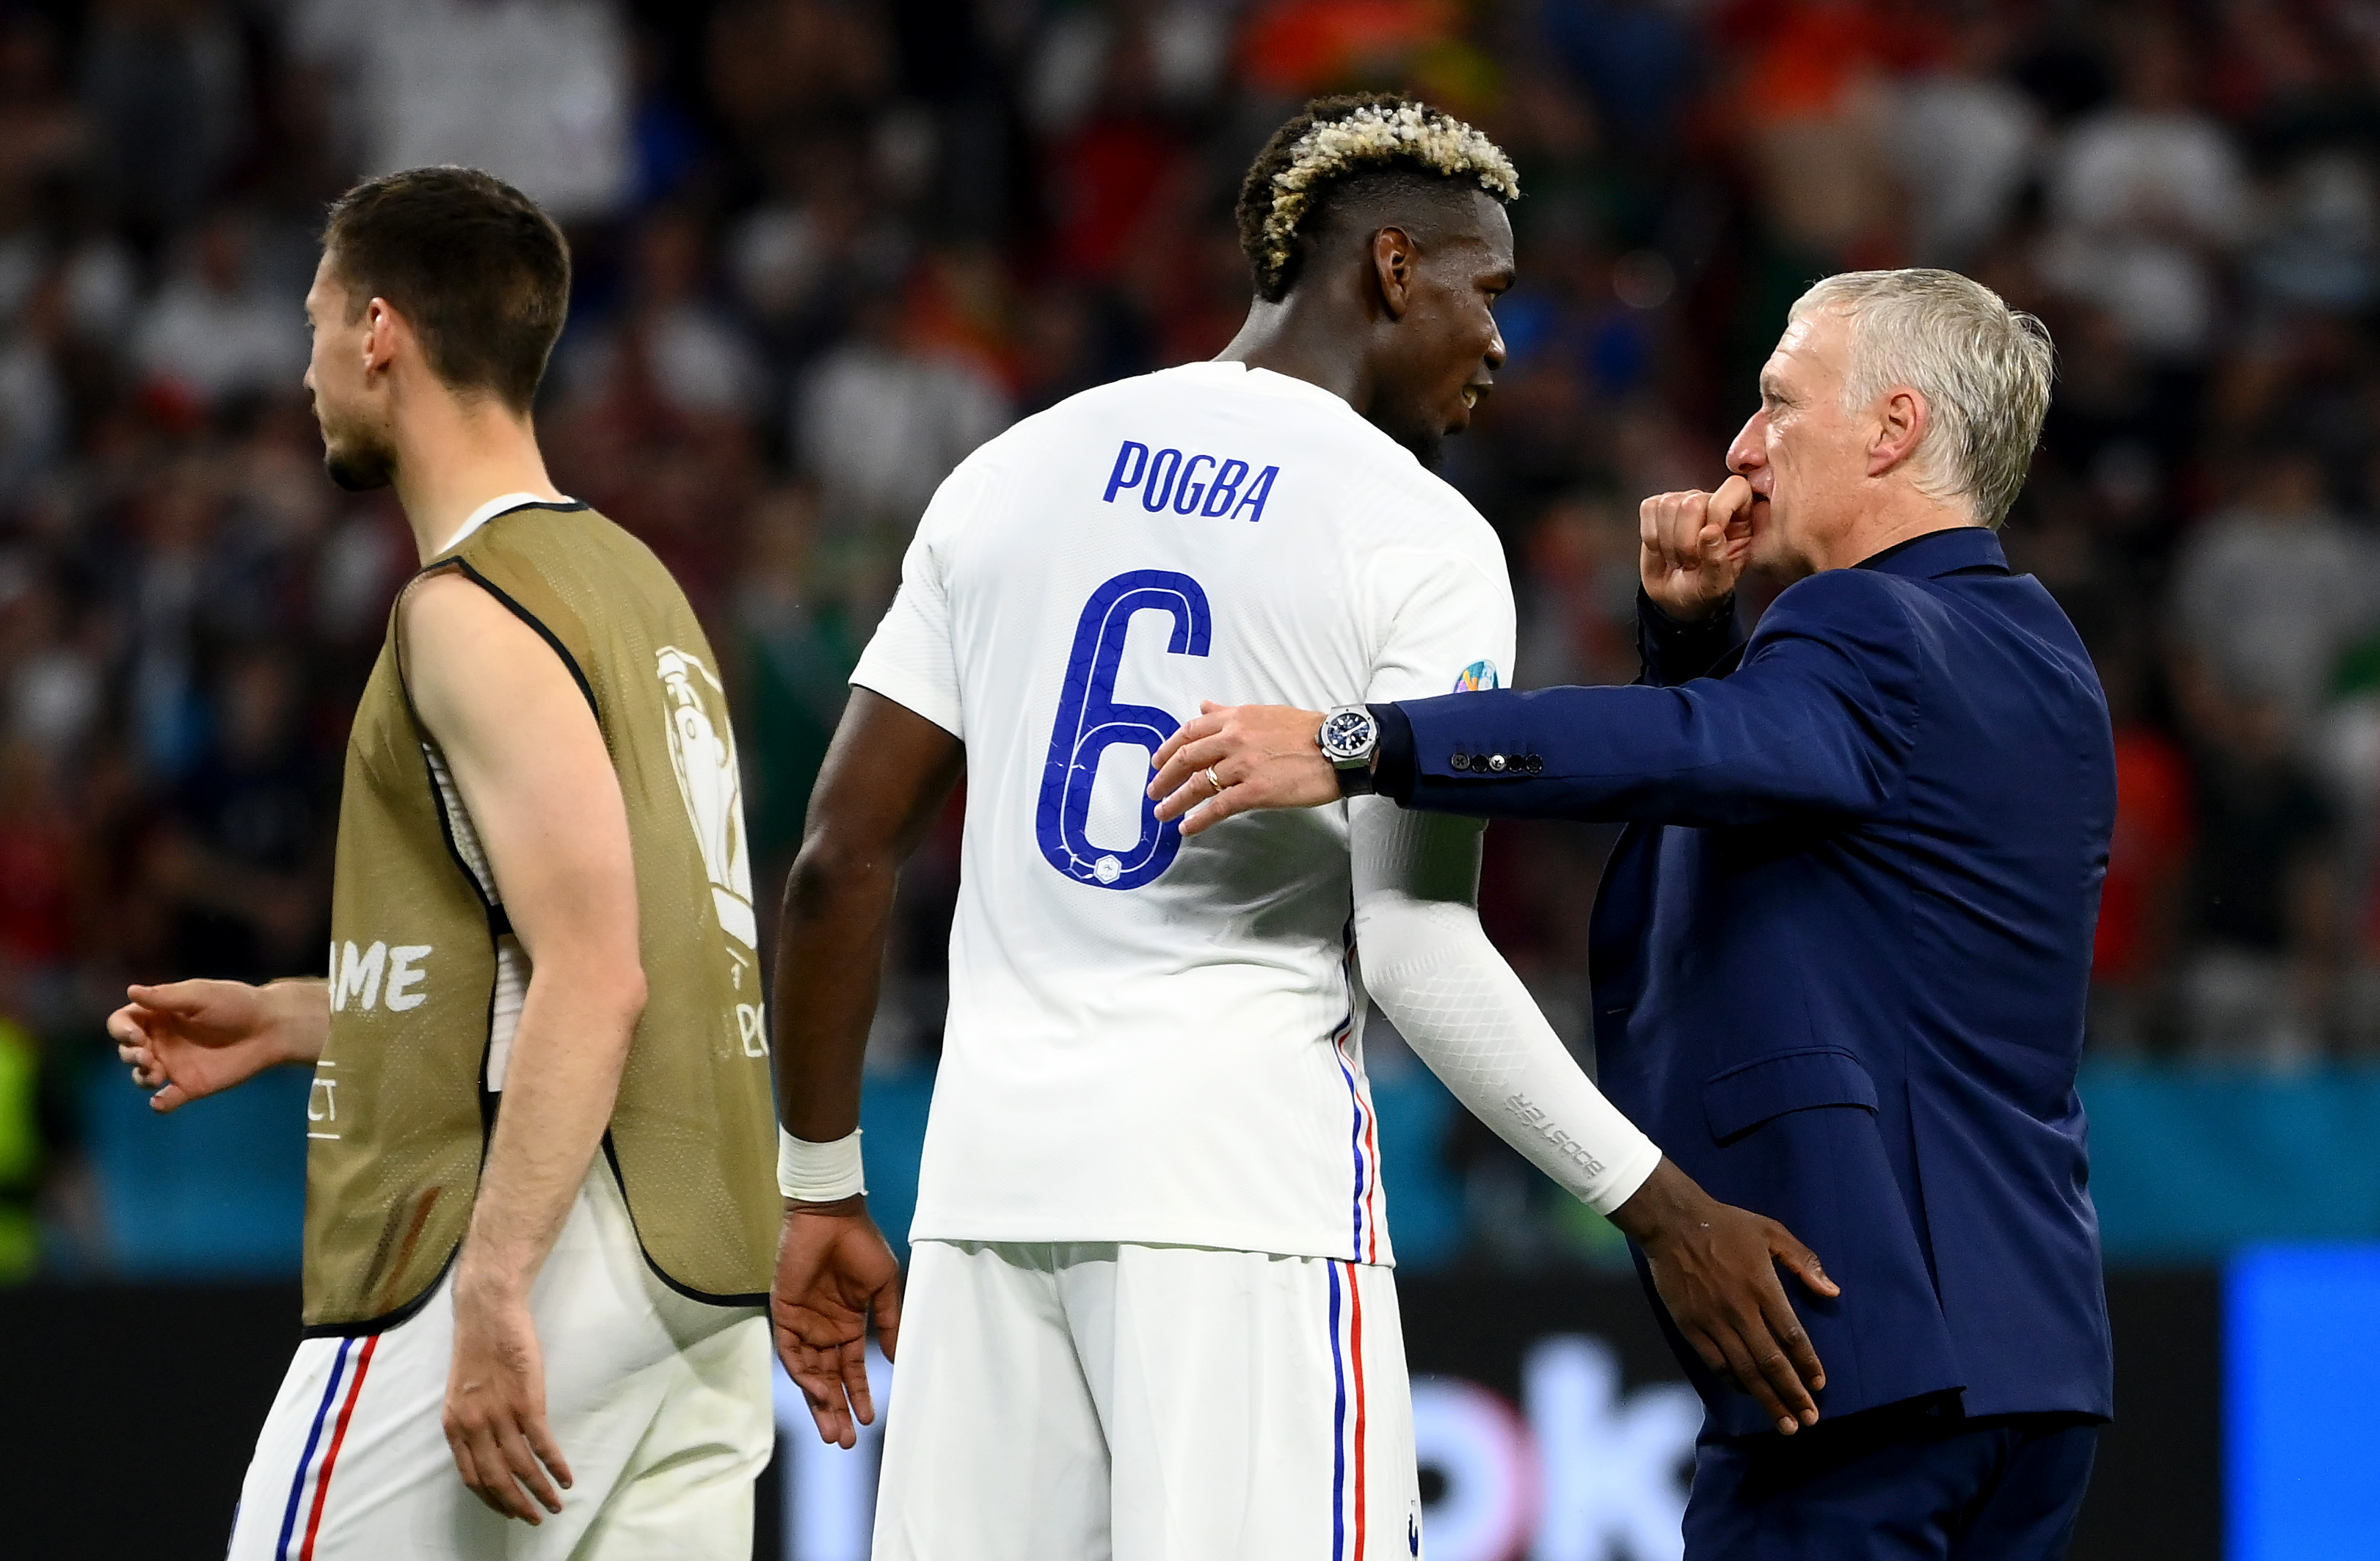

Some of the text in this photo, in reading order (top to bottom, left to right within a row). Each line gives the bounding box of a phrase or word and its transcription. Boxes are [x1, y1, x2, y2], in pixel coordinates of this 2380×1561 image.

[1103, 440, 1280, 523] POGBA
[1036, 569, 1212, 891] 6
[1504, 1092, 1607, 1179] BOOSTER
